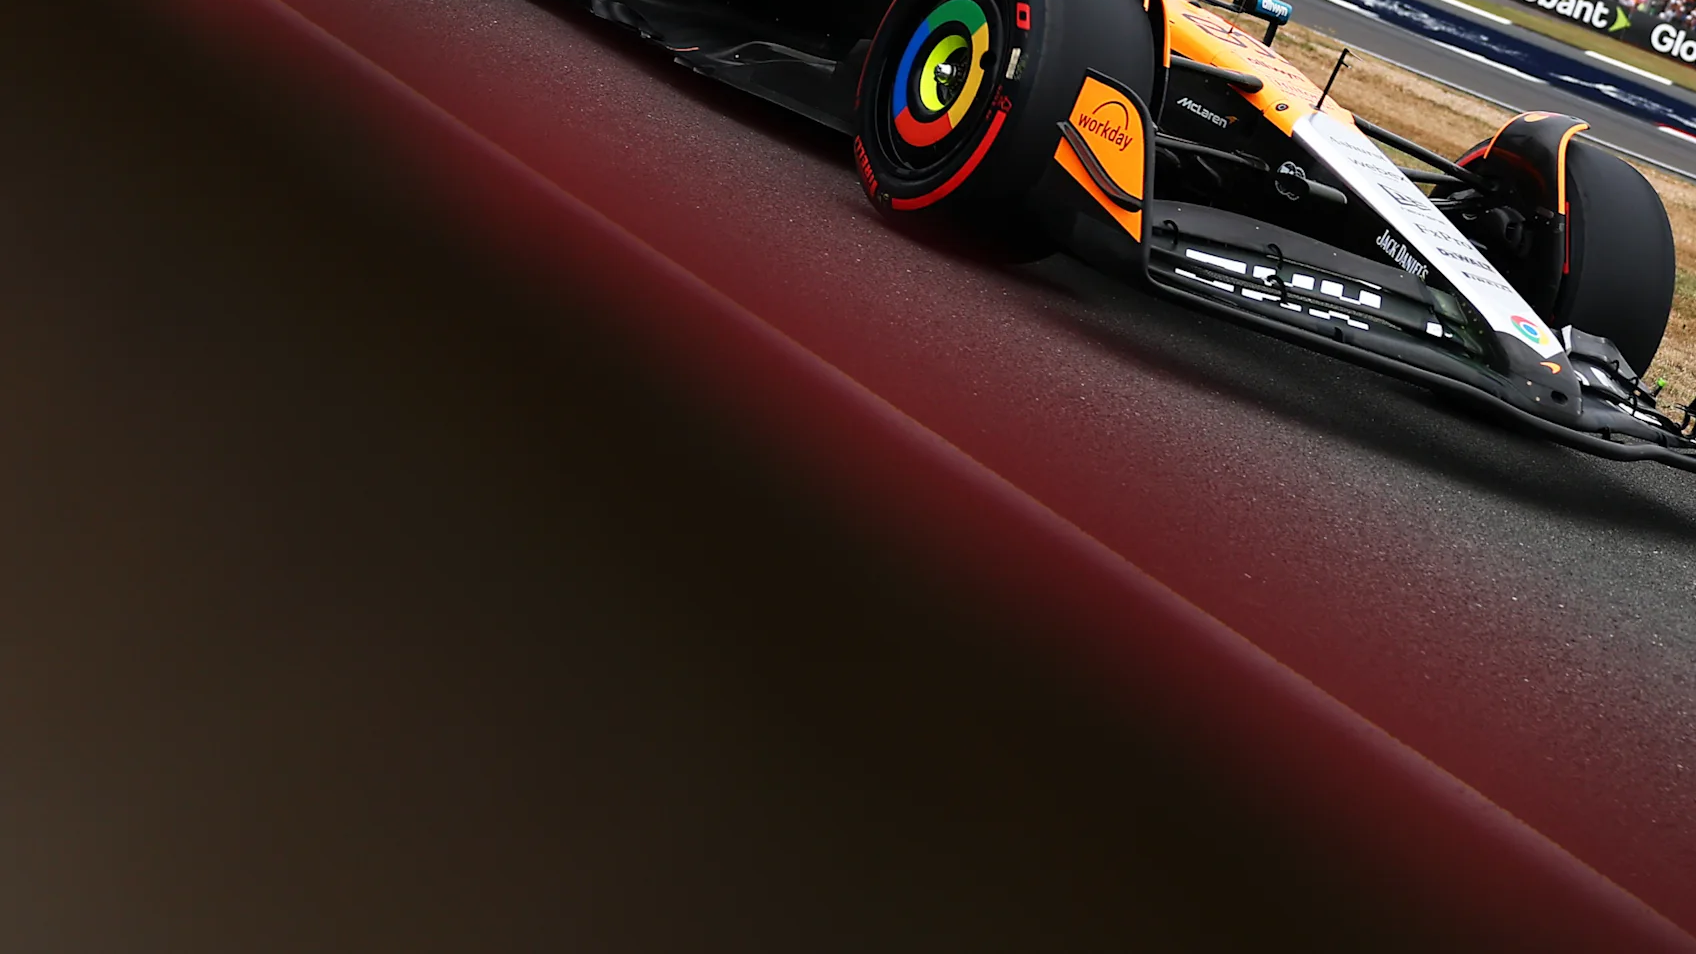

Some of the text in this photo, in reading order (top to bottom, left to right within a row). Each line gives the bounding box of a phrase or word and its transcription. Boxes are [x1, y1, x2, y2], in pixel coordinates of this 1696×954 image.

[1177, 97, 1228, 129] McLaren
[1078, 113, 1132, 151] workday
[1376, 229, 1399, 259] JACK
[1414, 222, 1474, 251] FxPro
